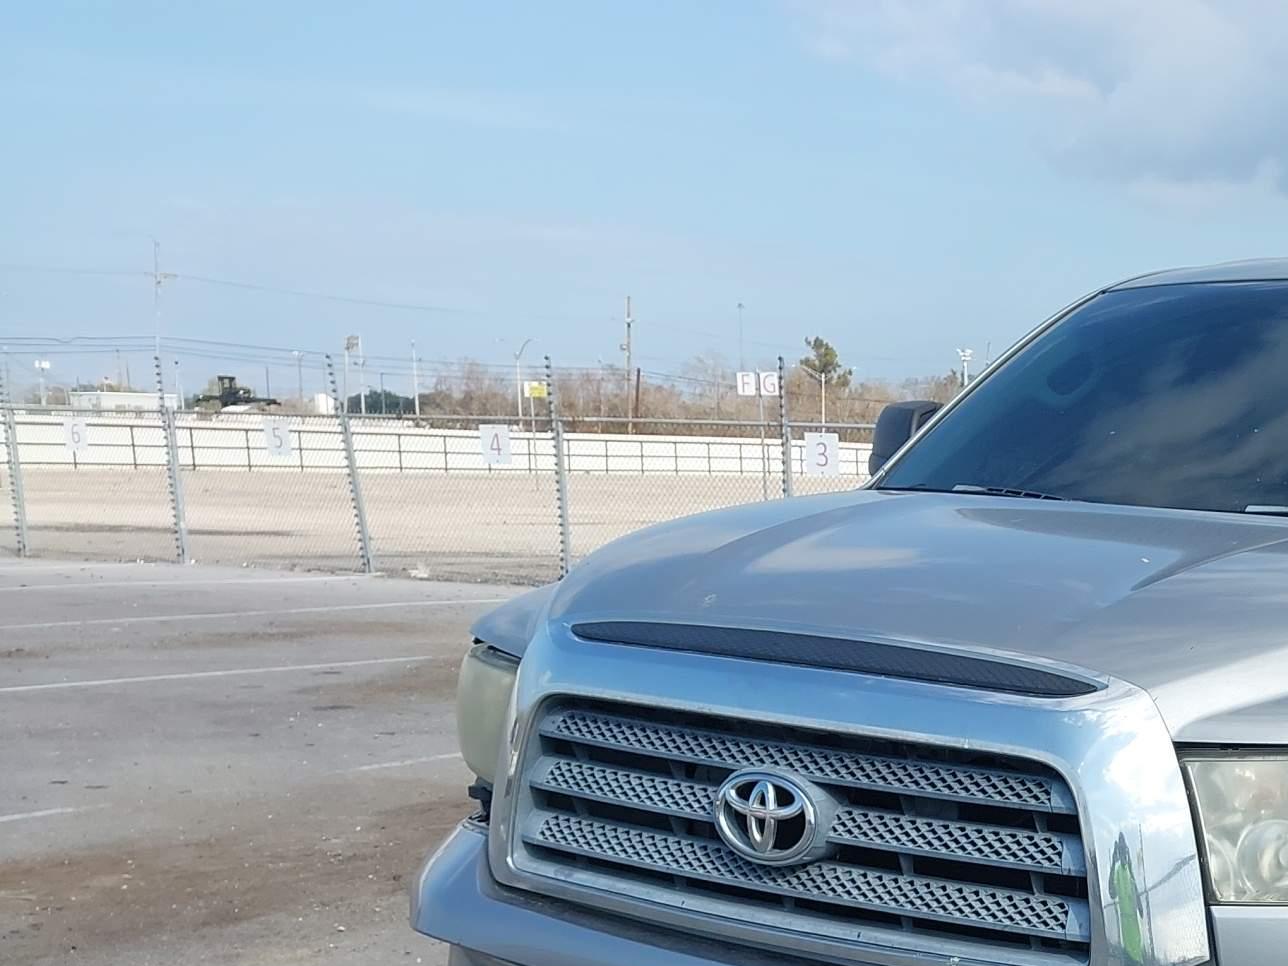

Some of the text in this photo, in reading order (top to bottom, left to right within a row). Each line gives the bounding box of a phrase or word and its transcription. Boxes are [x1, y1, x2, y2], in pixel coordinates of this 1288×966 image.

[741, 373, 751, 393] F
[762, 373, 776, 394] G
[71, 423, 81, 444] 6
[272, 427, 283, 449] 5
[490, 433, 502, 456] 4
[815, 441, 829, 467] 3
